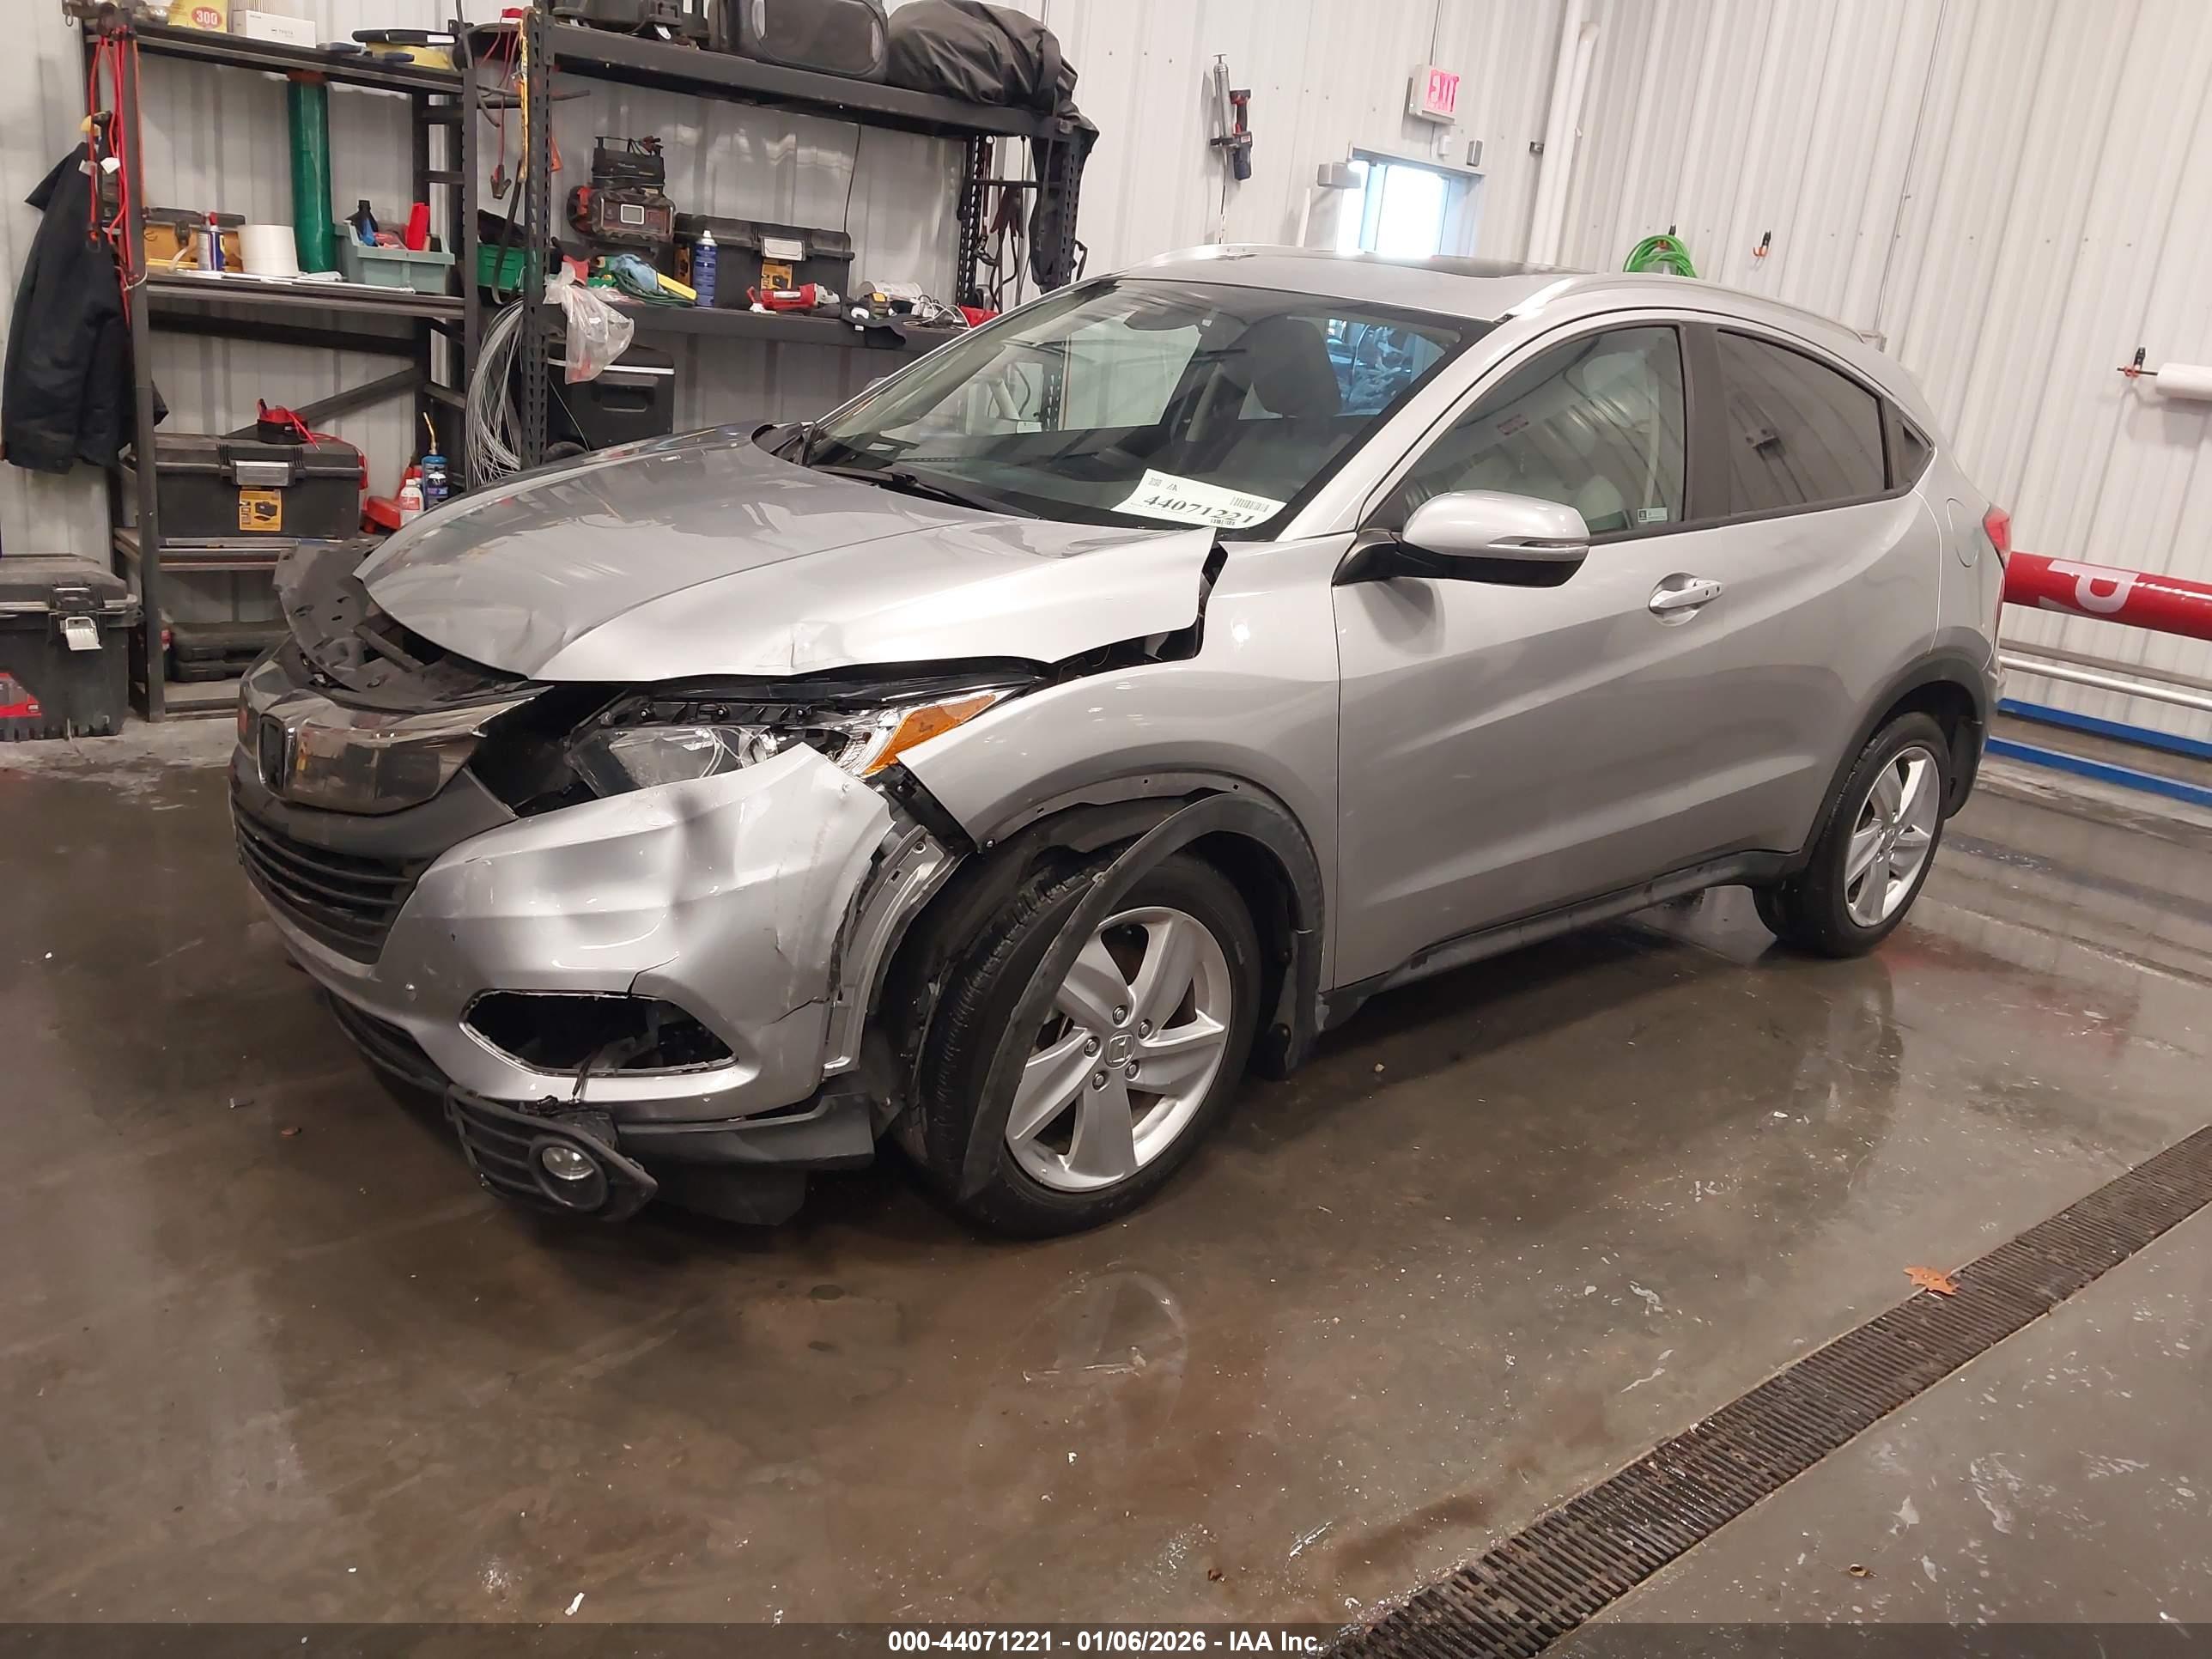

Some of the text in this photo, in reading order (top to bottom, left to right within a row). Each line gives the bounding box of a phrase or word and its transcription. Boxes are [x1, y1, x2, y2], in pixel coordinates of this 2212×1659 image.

[196, 9, 218, 25] 300
[1427, 70, 1460, 112] EXIT
[1144, 495, 1255, 524] 44071221
